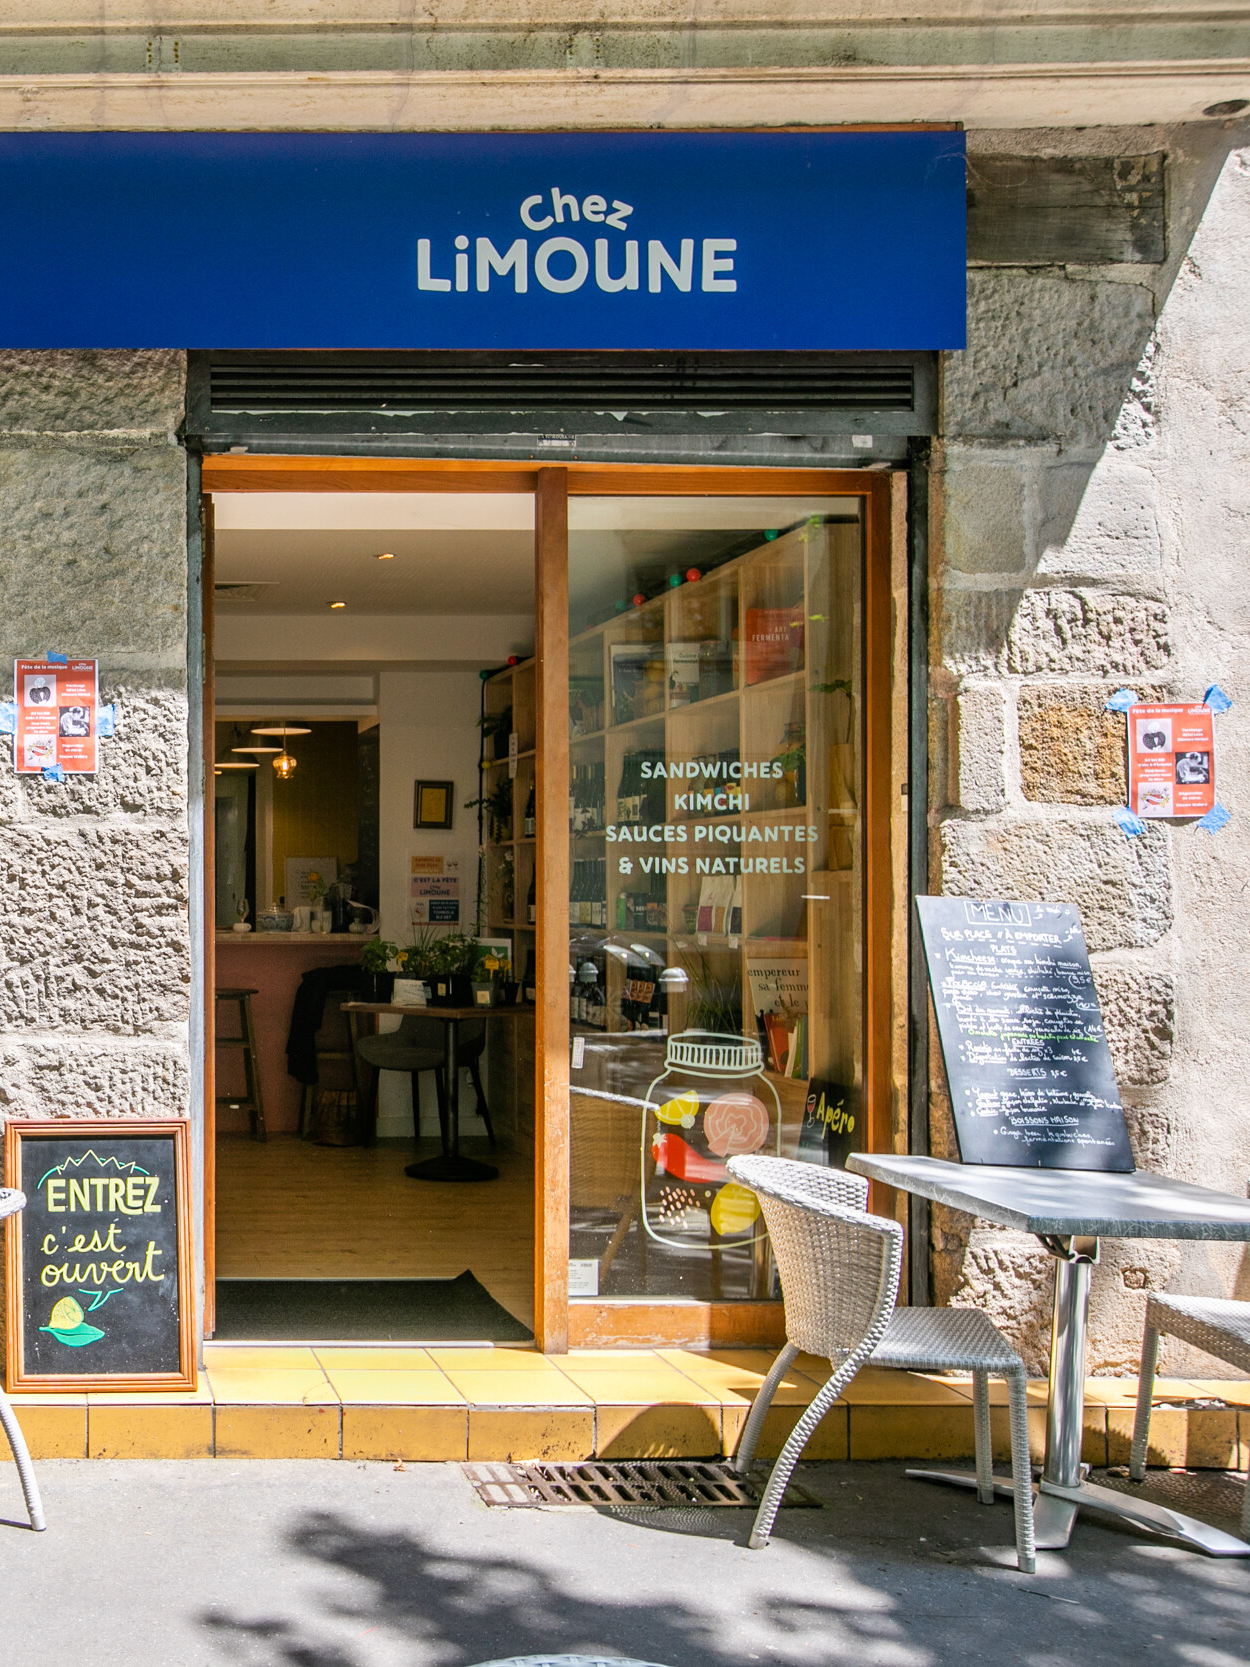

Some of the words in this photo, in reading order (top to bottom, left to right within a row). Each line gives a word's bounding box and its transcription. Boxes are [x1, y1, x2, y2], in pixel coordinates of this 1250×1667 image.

[640, 761, 783, 779] SANDWICHES
[674, 793, 749, 811] KIMCHI
[606, 825, 687, 842] SAUCES
[694, 825, 818, 844] PIQUANTES
[618, 857, 633, 875] &
[639, 857, 689, 875] VINS
[696, 857, 805, 875] NATURELS
[970, 904, 1024, 924] MENU
[963, 929, 993, 940] PLACE
[1014, 931, 1062, 944] EMPORTER
[990, 944, 1017, 953] PLATS
[748, 968, 801, 979] empereur
[758, 983, 770, 991] sa
[775, 977, 808, 991] femm
[789, 992, 799, 1007] le
[816, 1091, 855, 1140] Apéro
[1010, 1116, 1049, 1125] BOISSONS
[1050, 1116, 1079, 1124] MAISON
[47, 1176, 162, 1215] ENTREZ
[40, 1223, 127, 1255] c'est
[40, 1240, 165, 1287] ouvert
